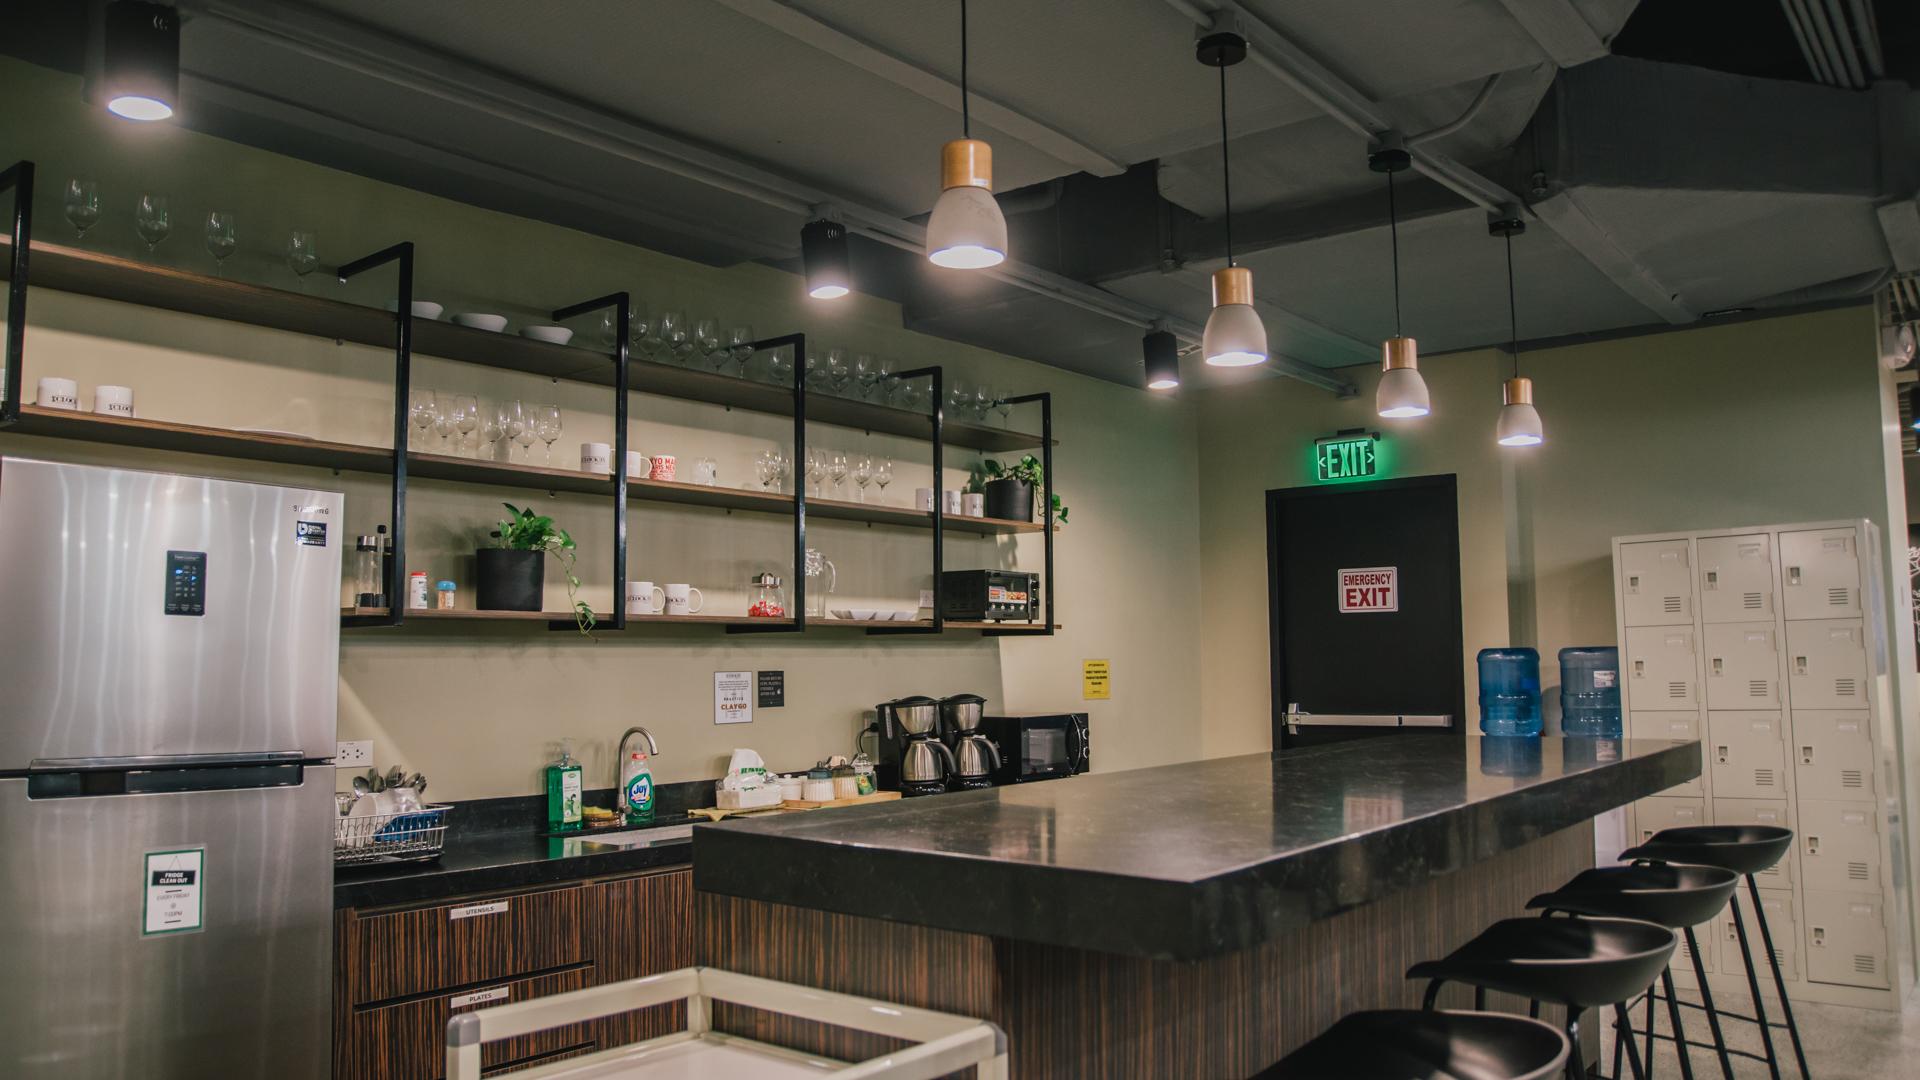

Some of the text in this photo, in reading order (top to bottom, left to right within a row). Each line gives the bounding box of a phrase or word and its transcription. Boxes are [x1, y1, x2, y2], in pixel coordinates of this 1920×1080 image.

[1326, 441, 1368, 478] EXIT
[1343, 573, 1391, 586] EMERGENCY
[1346, 587, 1390, 607] EXIT
[633, 784, 648, 796] Joy
[466, 905, 494, 915] UTENSILS
[469, 993, 492, 1002] PLATES
